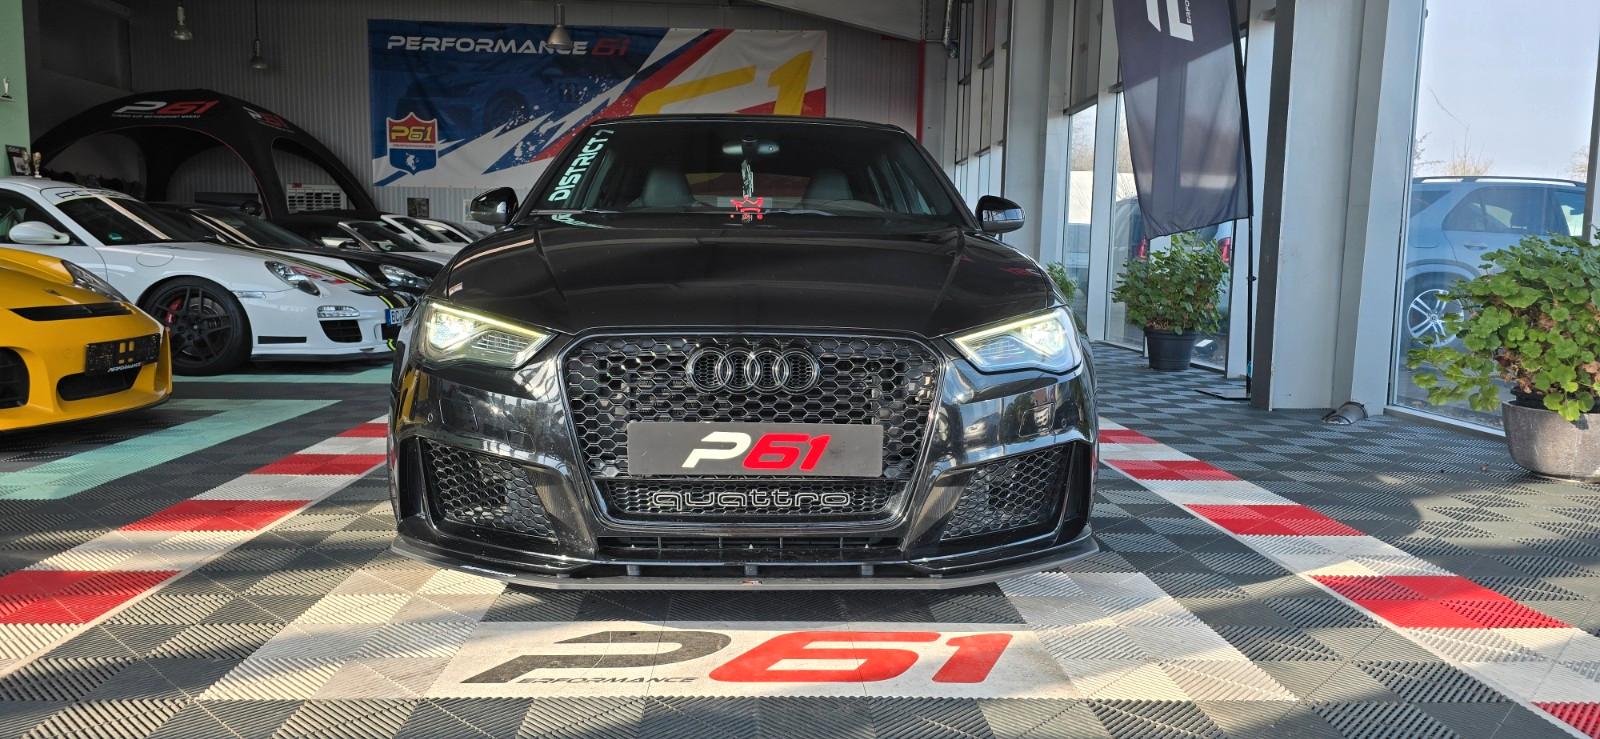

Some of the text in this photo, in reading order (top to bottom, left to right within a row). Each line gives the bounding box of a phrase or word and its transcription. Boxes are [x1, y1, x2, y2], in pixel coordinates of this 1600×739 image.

[113, 101, 219, 114] P61
[391, 126, 432, 141] P61
[548, 138, 608, 201] DISTRICT
[682, 432, 831, 471] P61
[652, 489, 850, 512] quattro
[460, 630, 1013, 684] P61
